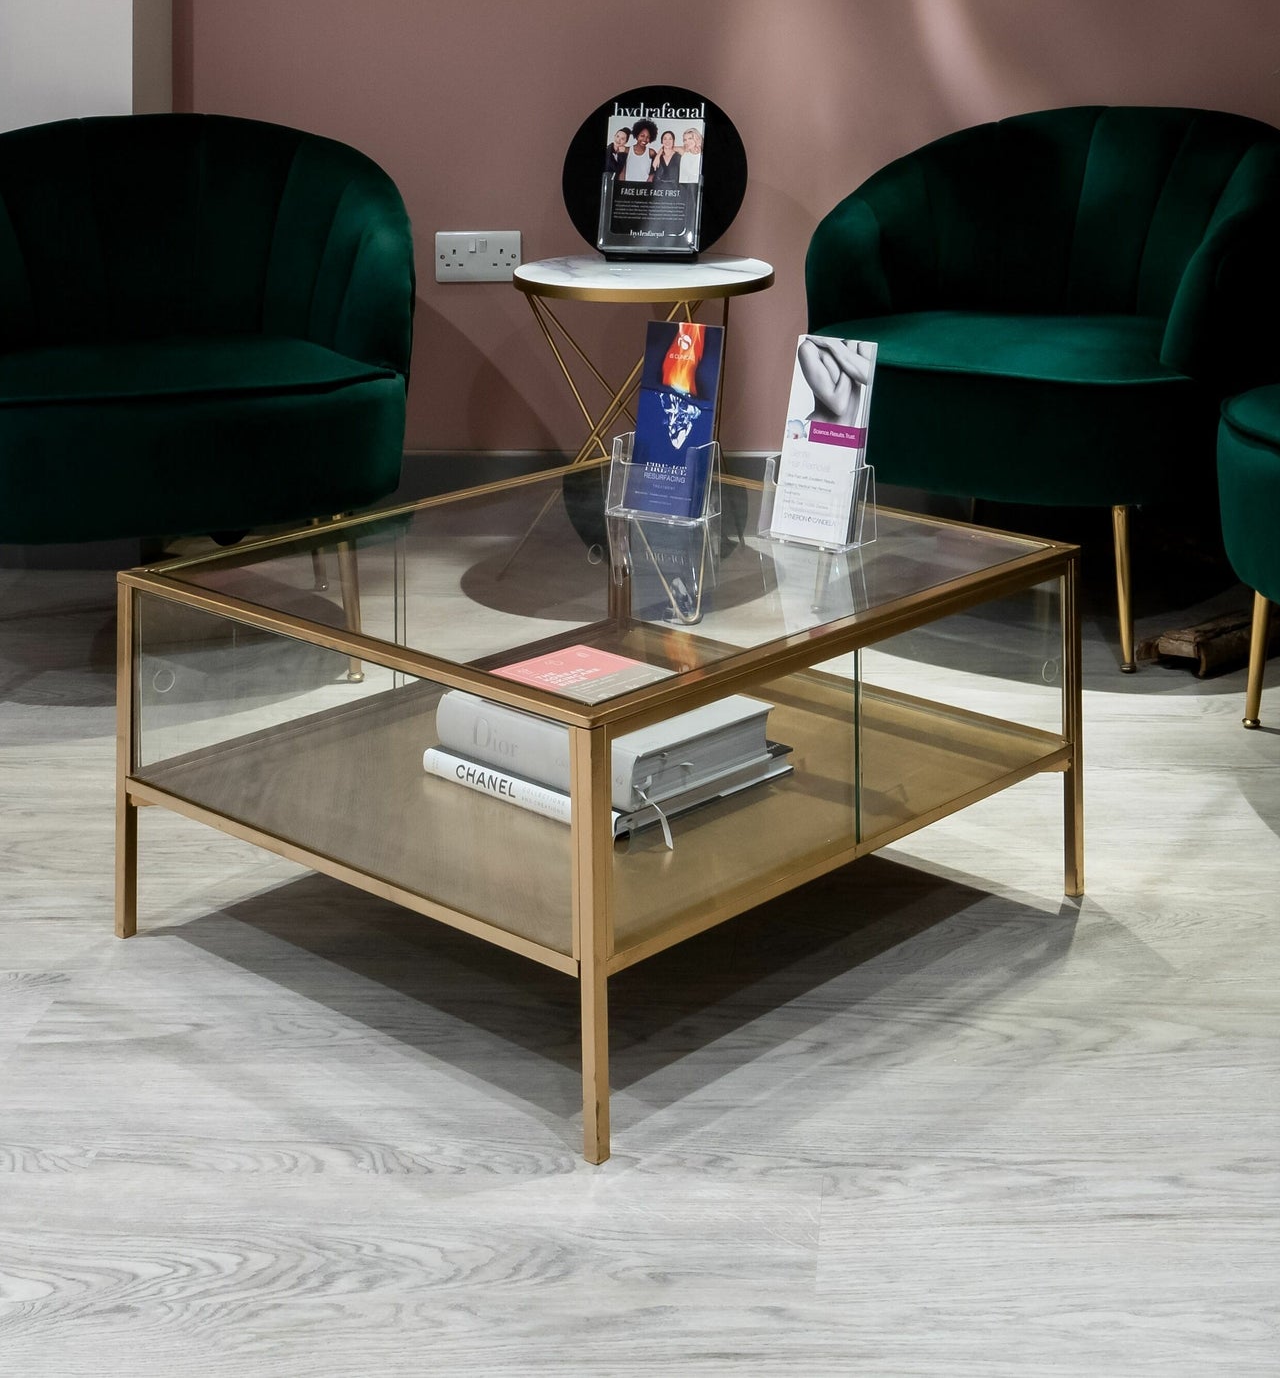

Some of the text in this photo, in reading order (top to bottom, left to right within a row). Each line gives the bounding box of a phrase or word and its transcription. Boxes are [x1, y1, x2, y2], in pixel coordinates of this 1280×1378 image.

[621, 188, 635, 196] FACE
[813, 428, 829, 436] Science.
[644, 472, 686, 484] RESURFACING
[473, 717, 518, 758] Dior
[456, 764, 516, 799] CHANEL
